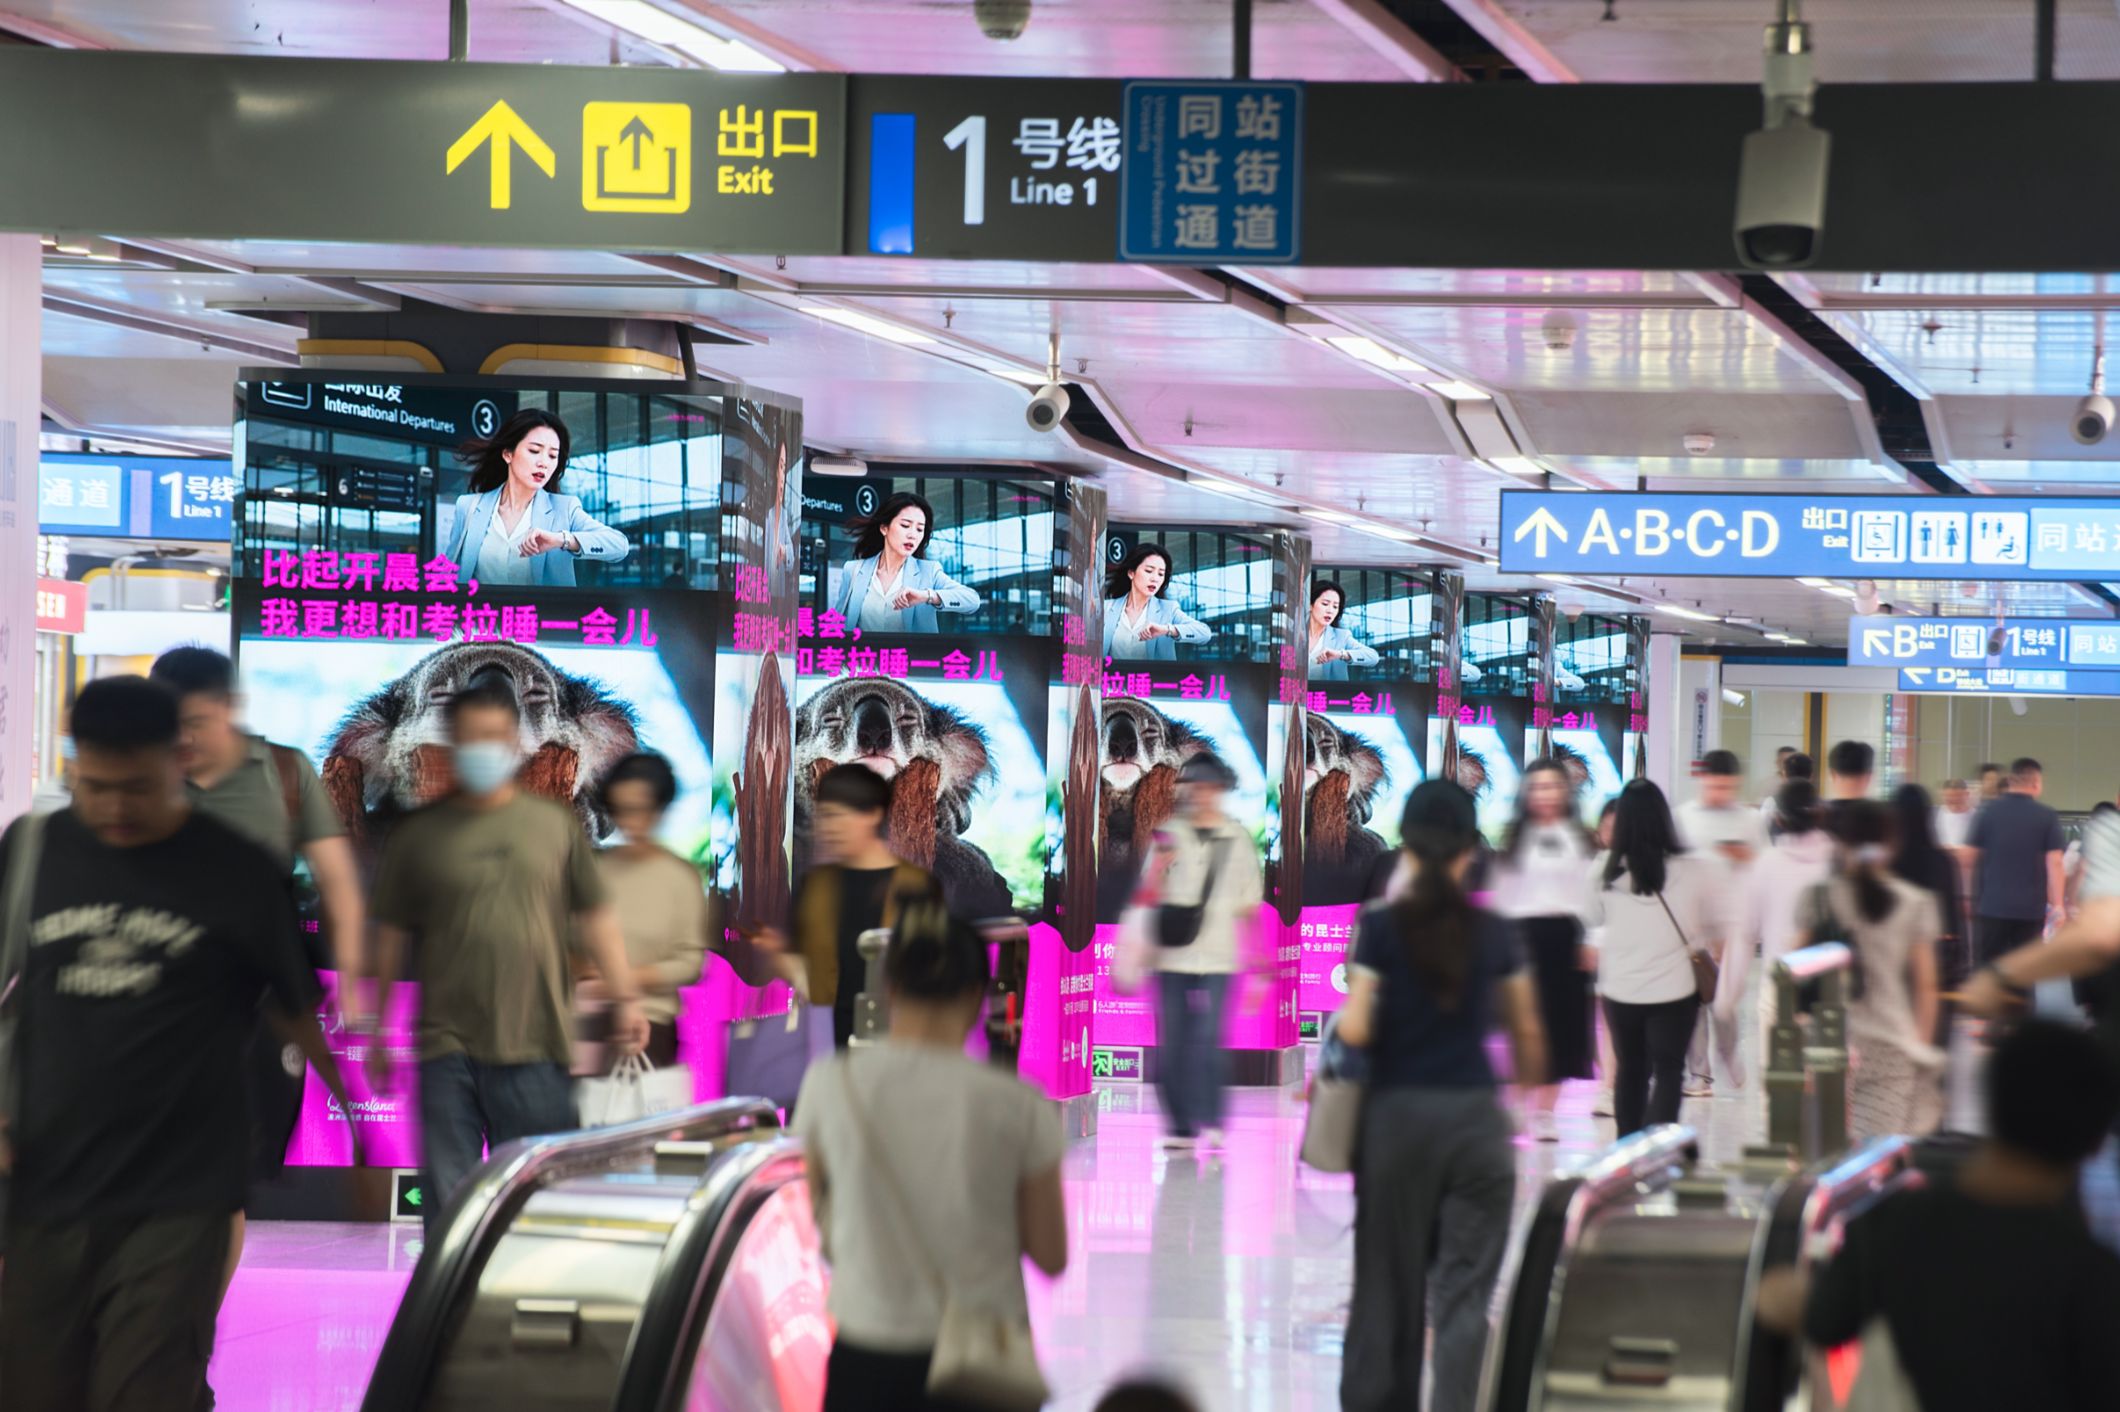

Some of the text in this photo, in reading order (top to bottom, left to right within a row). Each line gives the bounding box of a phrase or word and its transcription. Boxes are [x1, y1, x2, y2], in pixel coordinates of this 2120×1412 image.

[717, 104, 818, 158] 出口
[1178, 94, 1282, 140] 同站
[1012, 116, 1121, 172] 号线
[717, 164, 774, 195] Exit
[943, 115, 986, 224] 1
[1175, 148, 1281, 195] 过街
[1011, 175, 1097, 205] Line 1
[1173, 203, 1279, 249] 通道
[324, 396, 455, 434] International Departures
[480, 406, 493, 434] 3
[42, 478, 110, 508] 通道
[160, 472, 182, 518] 1
[185, 476, 234, 502] 号线
[863, 486, 873, 513] 3
[184, 504, 222, 518] Line 1
[1802, 506, 1847, 530] 出口
[1823, 535, 1849, 548] Exit
[260, 598, 658, 647] 我更想和考拉睡一会儿
[1920, 623, 1949, 639] 出口
[2021, 629, 2056, 646] 号线
[1894, 625, 1918, 658] B
[2006, 626, 2021, 657] 1
[1102, 671, 1231, 701] 拉睡一会儿
